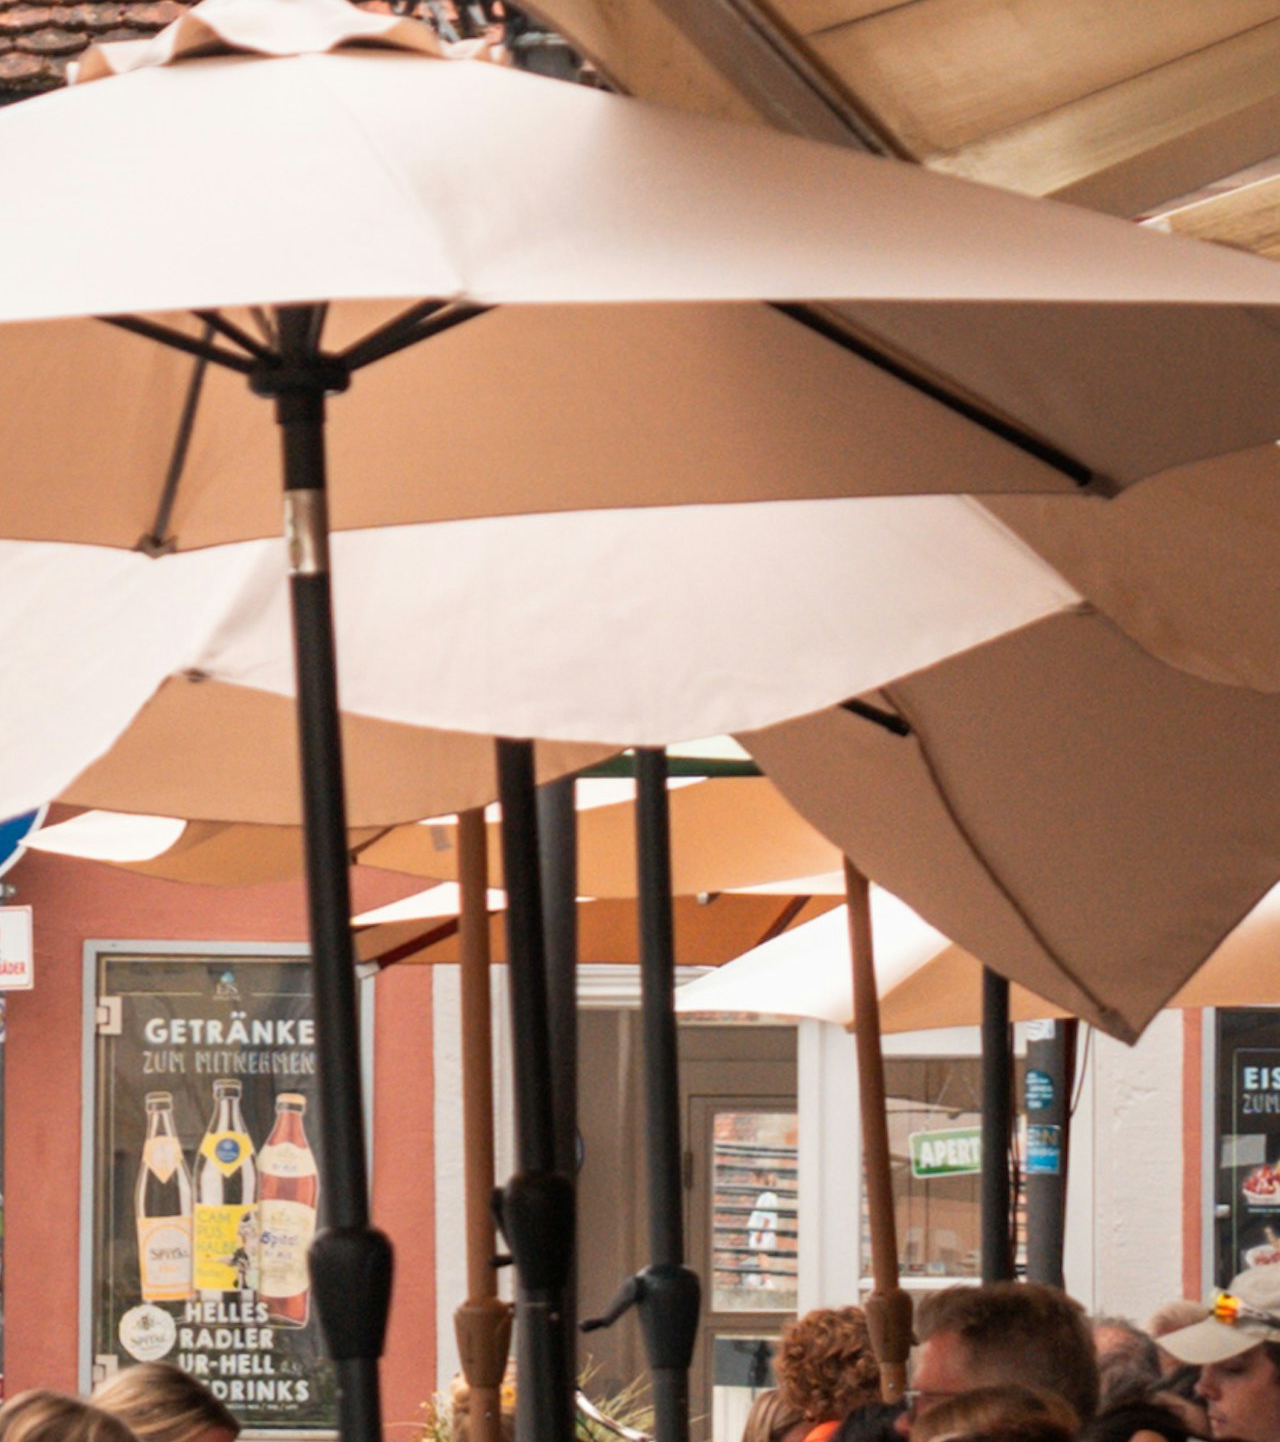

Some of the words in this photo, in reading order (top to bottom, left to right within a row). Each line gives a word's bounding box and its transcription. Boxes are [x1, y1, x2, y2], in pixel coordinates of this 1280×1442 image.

[144, 1010, 316, 1045] GETRÄNKE
[142, 1050, 186, 1074] ZUM
[195, 1050, 316, 1075] MITNEHMEN
[920, 1137, 983, 1169] APERT
[184, 1302, 269, 1323] HELLES
[178, 1328, 274, 1349] RADLER
[178, 1353, 276, 1375] UR-HELL
[202, 1380, 310, 1402] DRINKS
